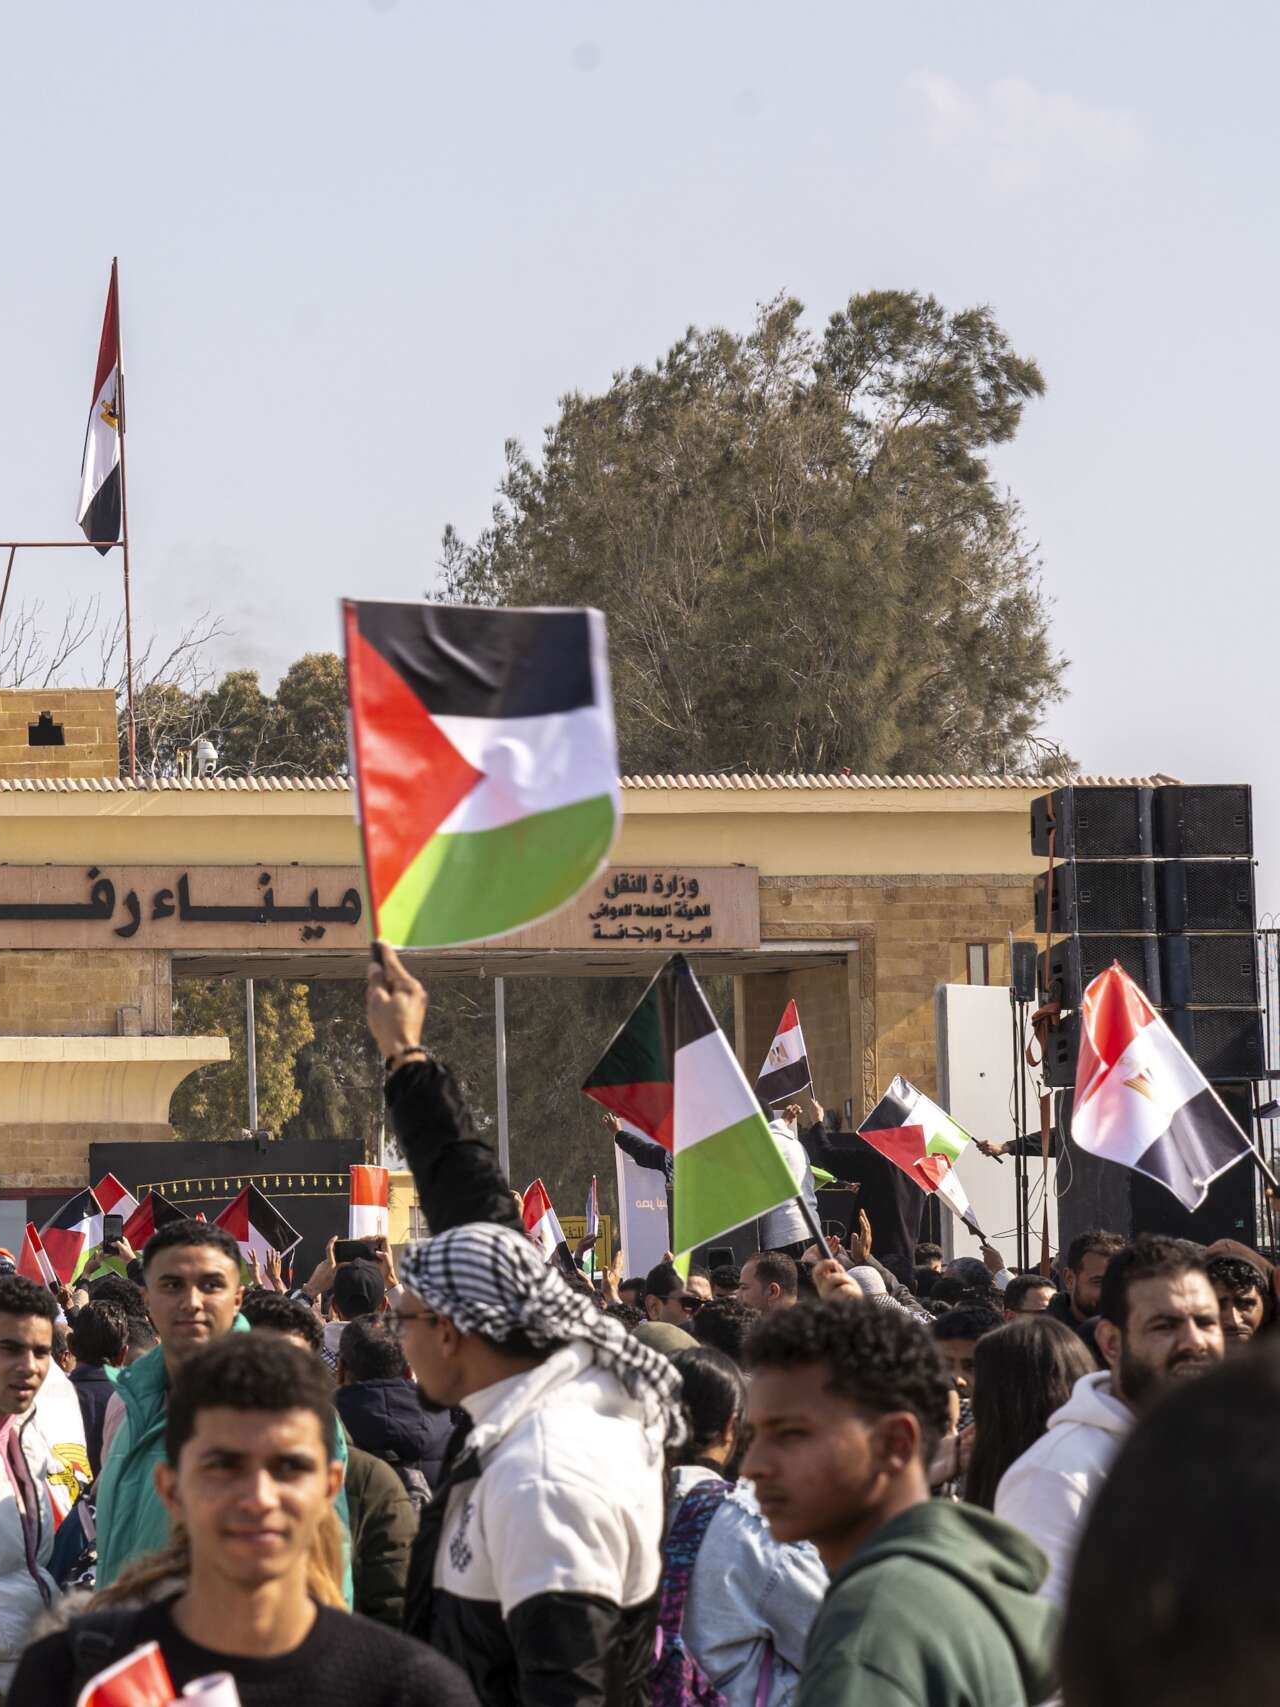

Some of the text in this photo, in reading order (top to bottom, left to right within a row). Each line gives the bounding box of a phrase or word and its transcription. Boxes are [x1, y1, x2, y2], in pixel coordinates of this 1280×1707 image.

[604, 873, 699, 898] وزارة النقل
[151, 872, 362, 942] ميناء
[635, 903, 671, 917] العامة
[674, 901, 711, 920] الهيئة
[666, 924, 712, 942] البرية
